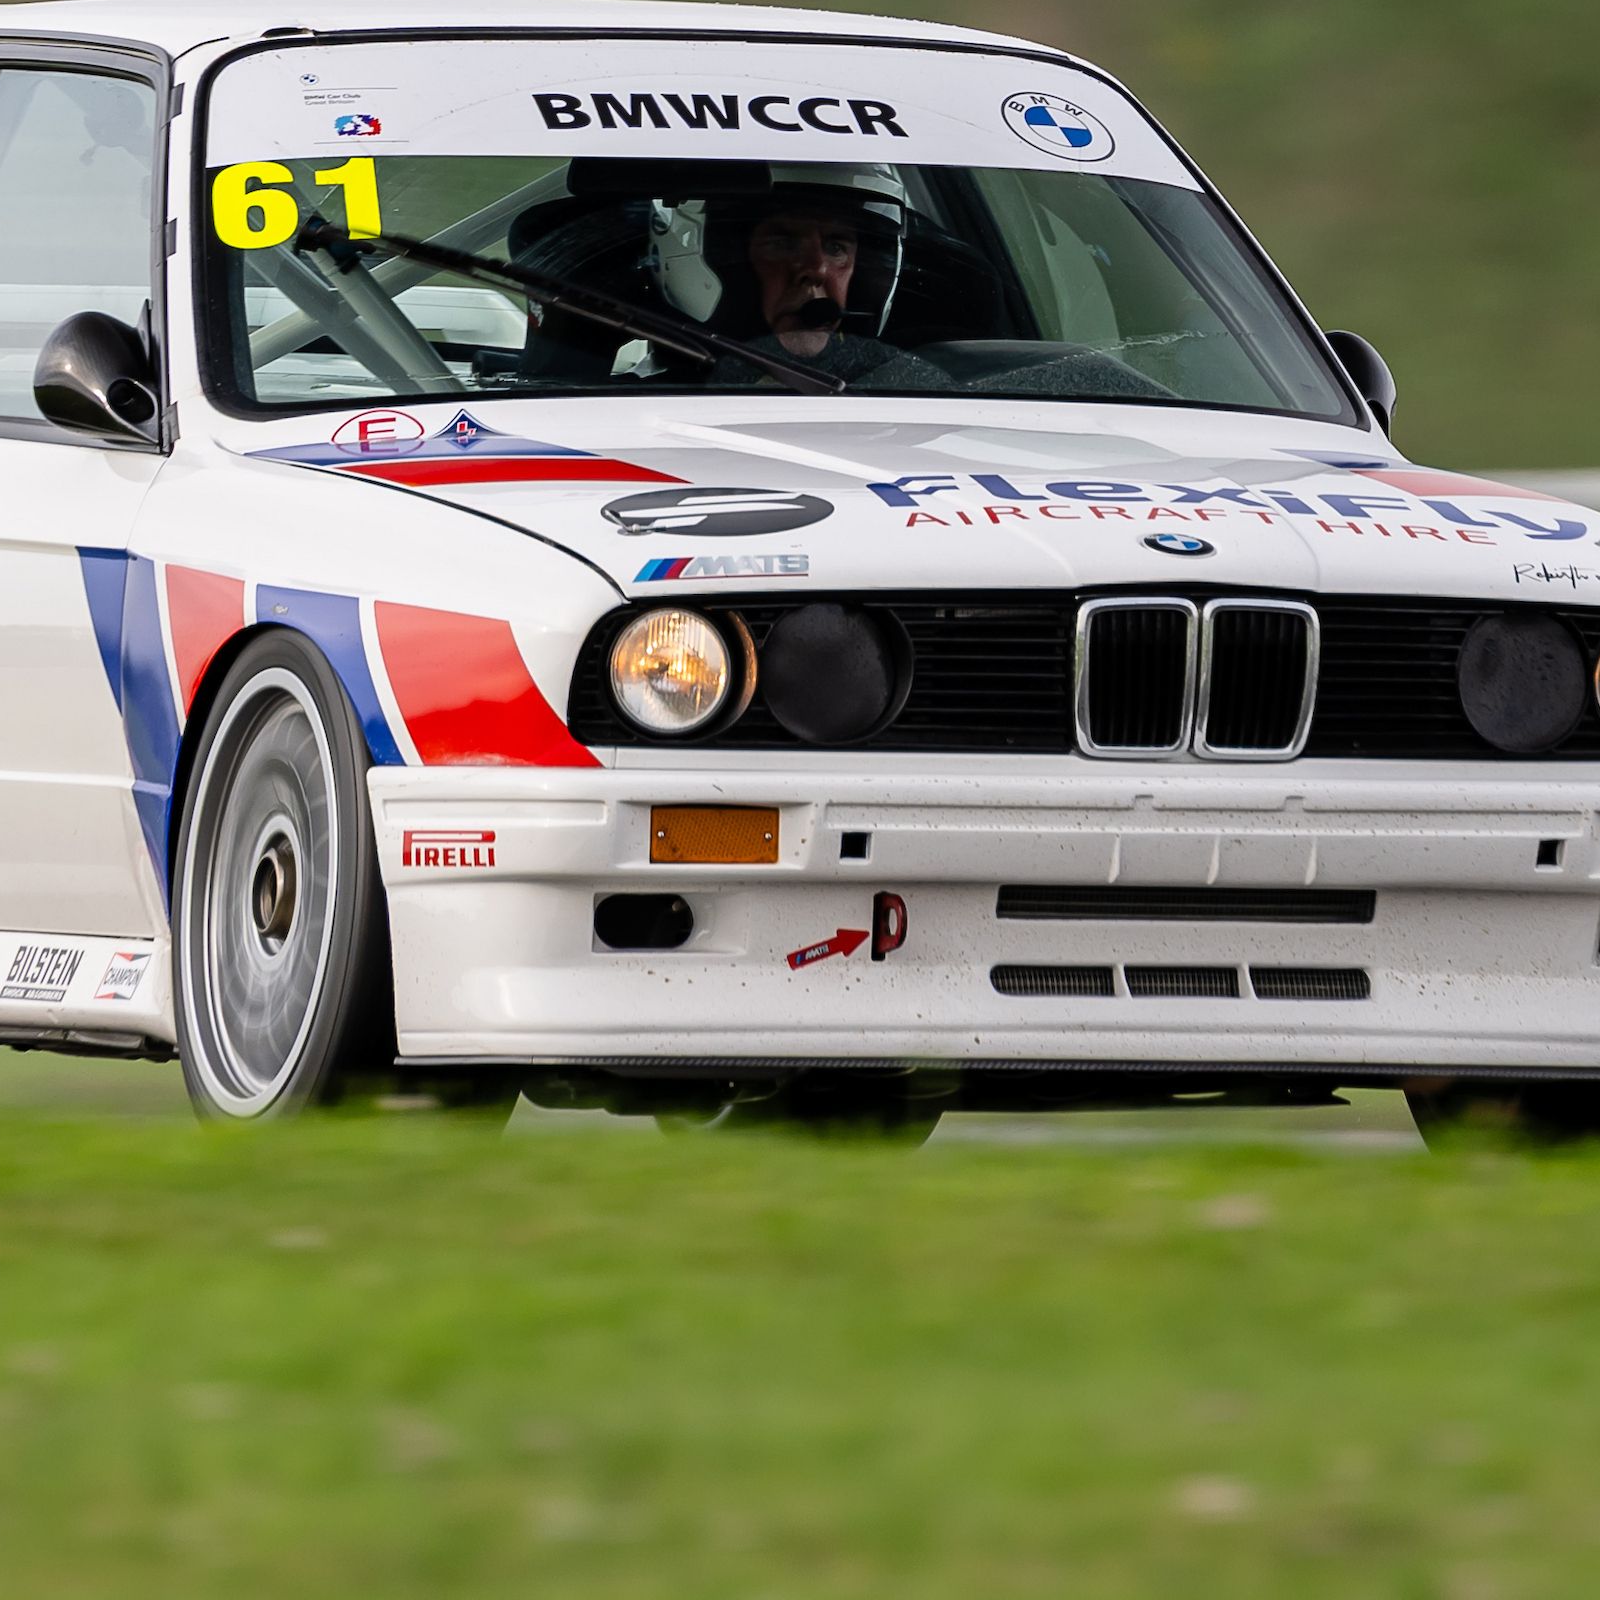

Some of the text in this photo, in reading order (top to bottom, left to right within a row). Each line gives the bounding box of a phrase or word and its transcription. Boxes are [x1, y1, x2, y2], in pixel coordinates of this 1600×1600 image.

[532, 93, 909, 138] BMWCCR
[1008, 95, 1083, 117] BMW
[211, 156, 382, 249] 61
[358, 417, 399, 452] E
[905, 504, 1498, 546] AIRCRAFT HIRE
[402, 830, 496, 867] PIRELLI
[6, 945, 86, 987] BILSTEIN
[104, 966, 144, 988] CHAMPION
